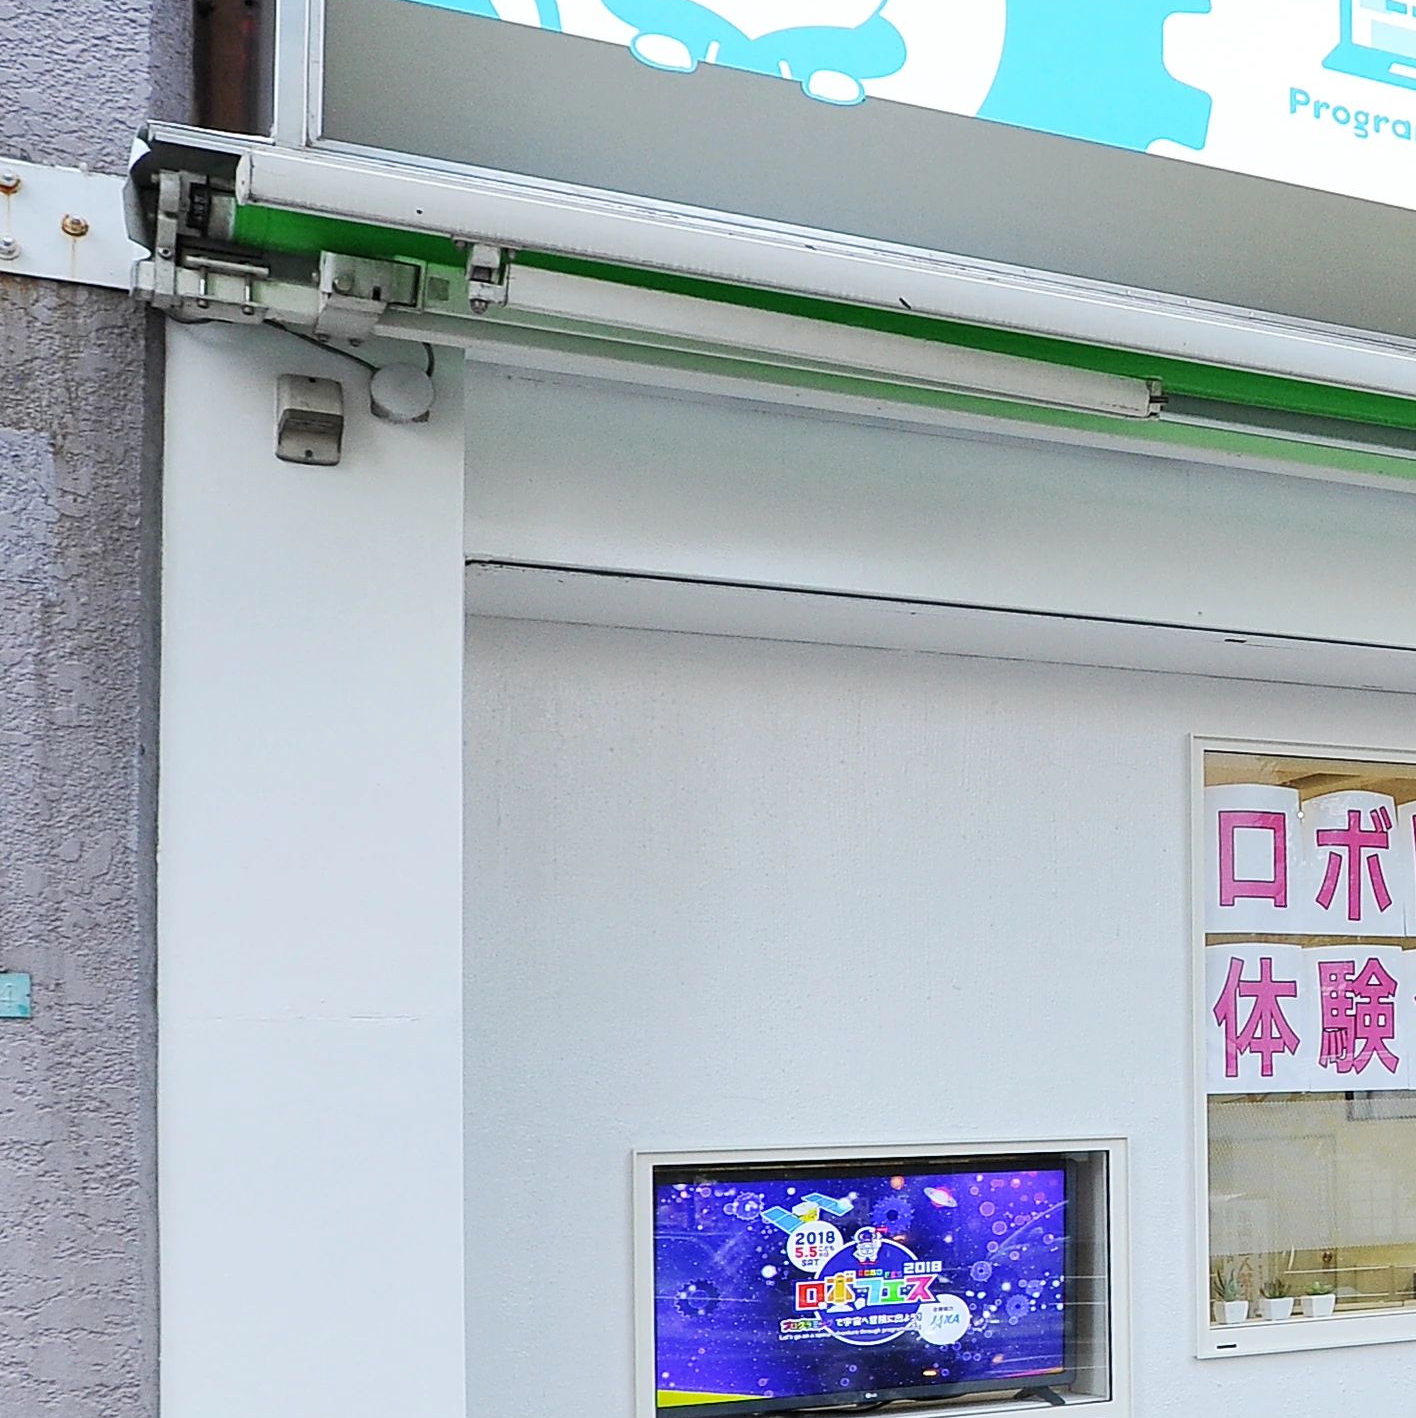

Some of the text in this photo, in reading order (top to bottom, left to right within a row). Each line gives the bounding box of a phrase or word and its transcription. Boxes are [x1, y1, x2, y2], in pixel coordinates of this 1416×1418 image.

[795, 1231, 836, 1245] 2018
[794, 1246, 818, 1258] 5.5
[903, 1261, 942, 1274] 2018
